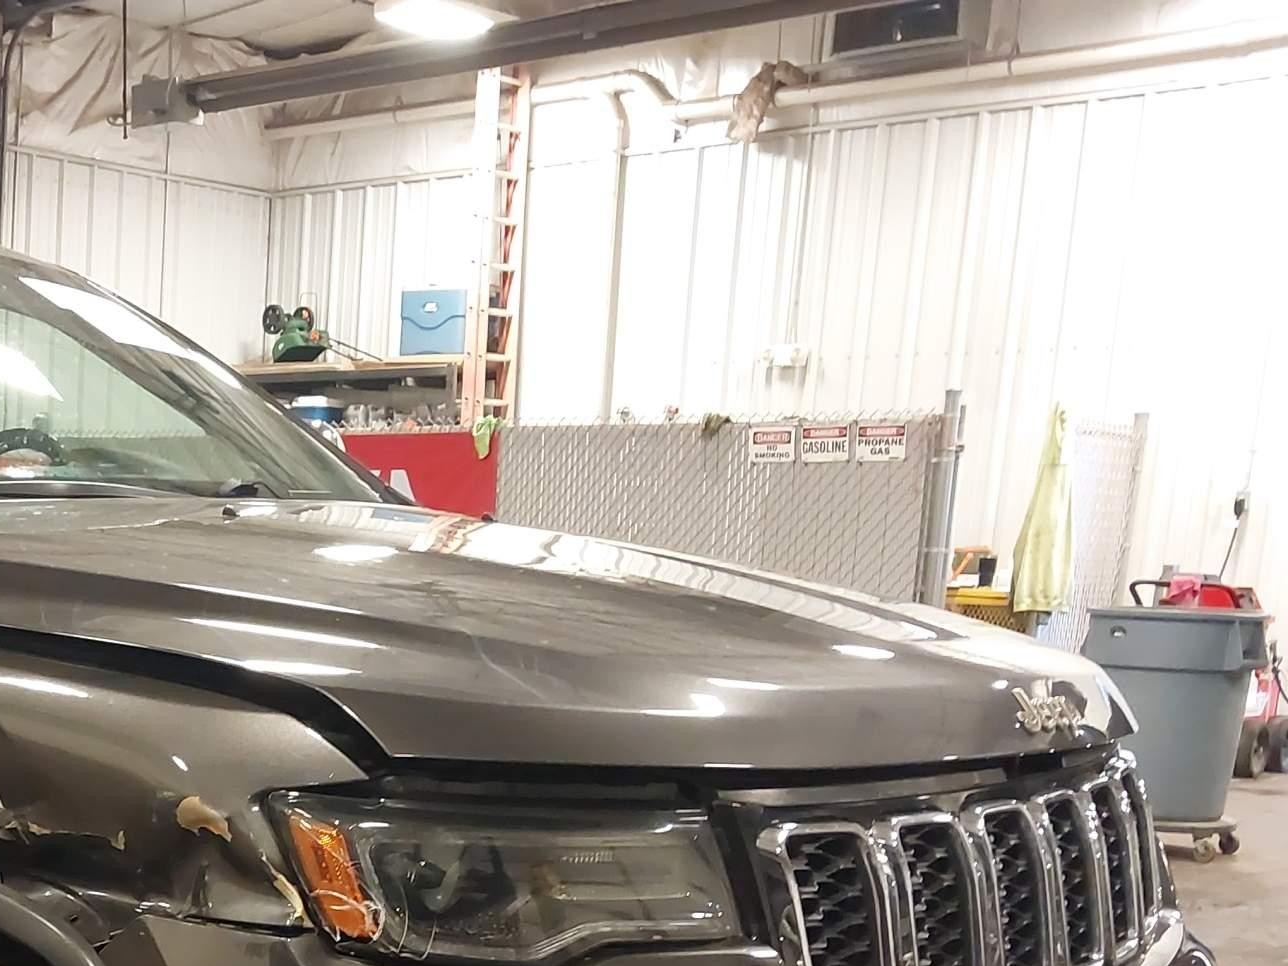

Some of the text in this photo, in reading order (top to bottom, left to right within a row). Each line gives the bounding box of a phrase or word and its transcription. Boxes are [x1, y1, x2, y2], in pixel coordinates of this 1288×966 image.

[802, 440, 847, 453] GASOLINE
[857, 438, 904, 447] PROPANE
[870, 447, 890, 455] GAS
[1011, 687, 1084, 740] Jeep
